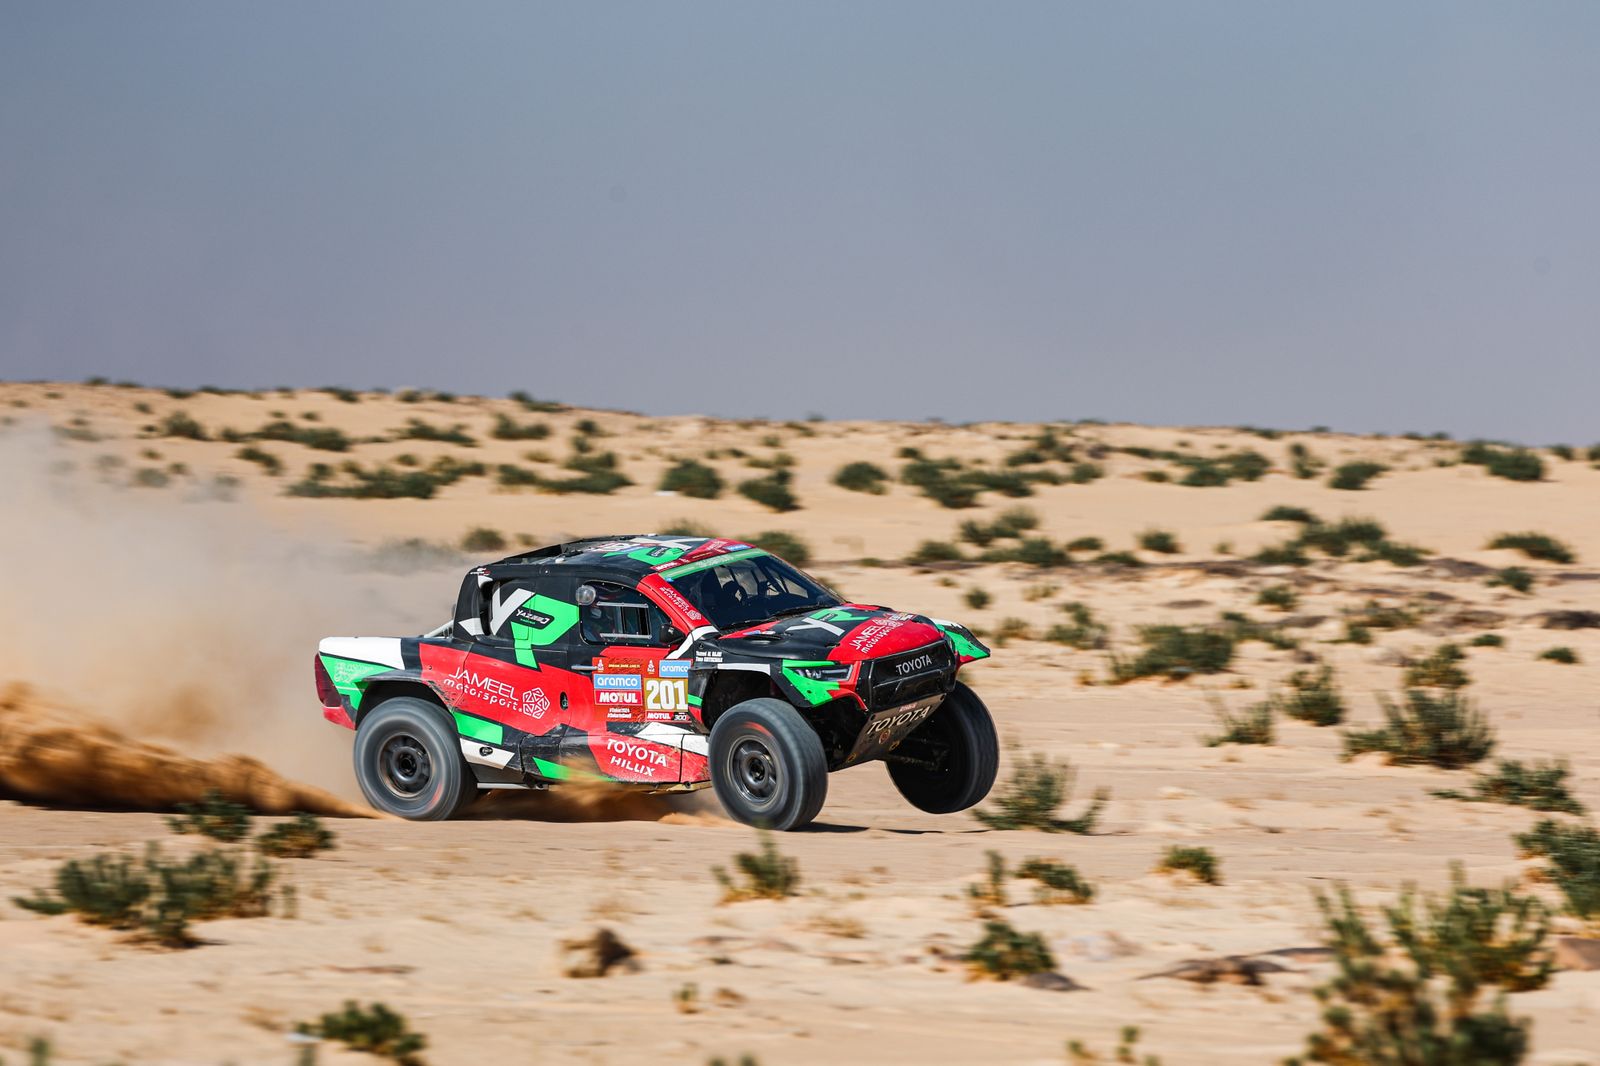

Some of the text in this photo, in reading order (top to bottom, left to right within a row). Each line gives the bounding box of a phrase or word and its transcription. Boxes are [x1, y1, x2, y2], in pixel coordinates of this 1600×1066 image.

[849, 625, 885, 650] JAMEEL
[661, 665, 689, 673] aramco
[895, 654, 933, 676] TOYOTA
[448, 667, 519, 701] JAMEEL
[597, 677, 638, 687] aramco
[599, 692, 638, 703] MOTUL
[646, 680, 689, 710] 201
[867, 705, 931, 735] TOYOTA
[606, 738, 668, 768] TOYOTA
[610, 755, 656, 777] HILUX
